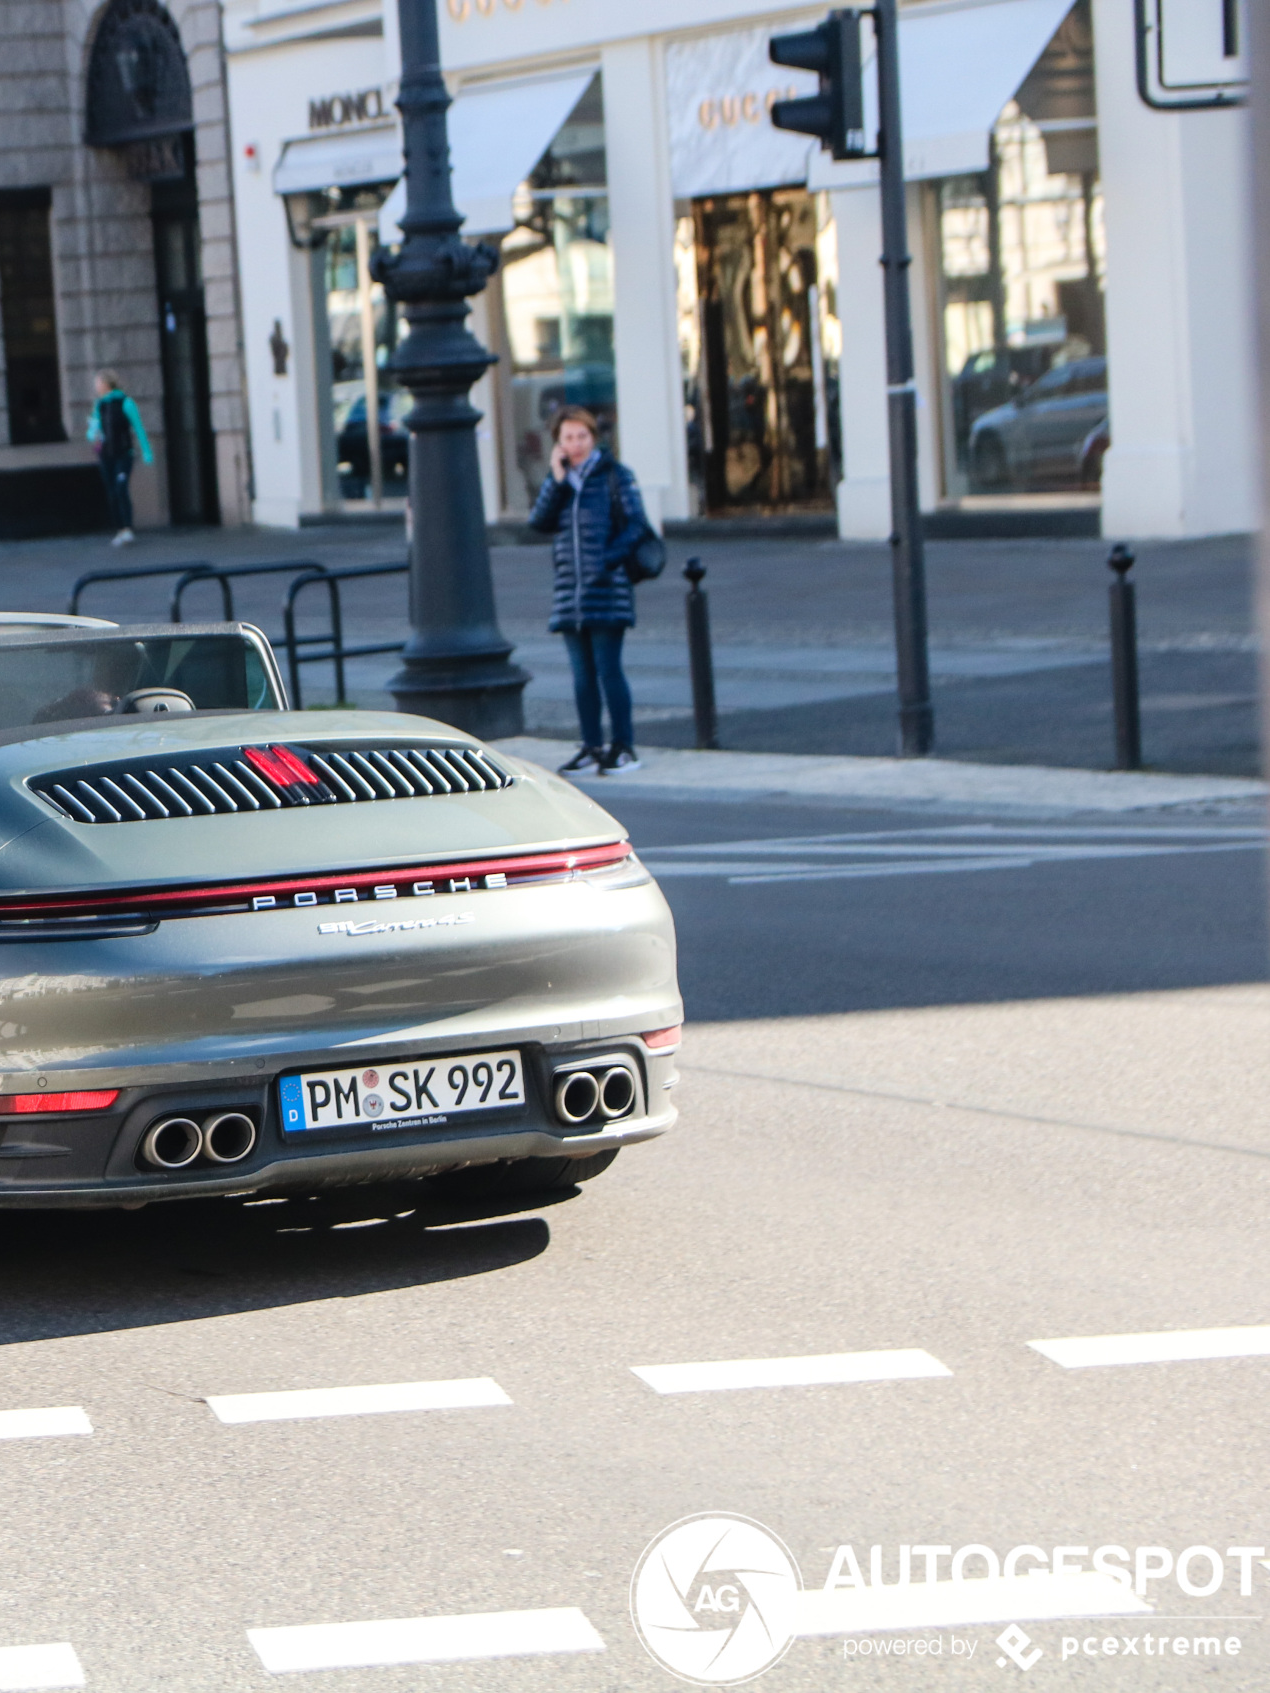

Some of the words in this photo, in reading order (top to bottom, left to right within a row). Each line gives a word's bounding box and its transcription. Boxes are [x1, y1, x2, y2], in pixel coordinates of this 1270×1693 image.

[252, 872, 508, 911] PORSCHE
[317, 920, 355, 935] 911
[346, 917, 436, 936] Carrera
[307, 1076, 360, 1122] PM
[388, 1067, 440, 1112] SK
[448, 1059, 520, 1106] 992
[289, 1109, 299, 1123] D
[372, 1121, 397, 1131] Porsche
[429, 1115, 447, 1124] Berlin
